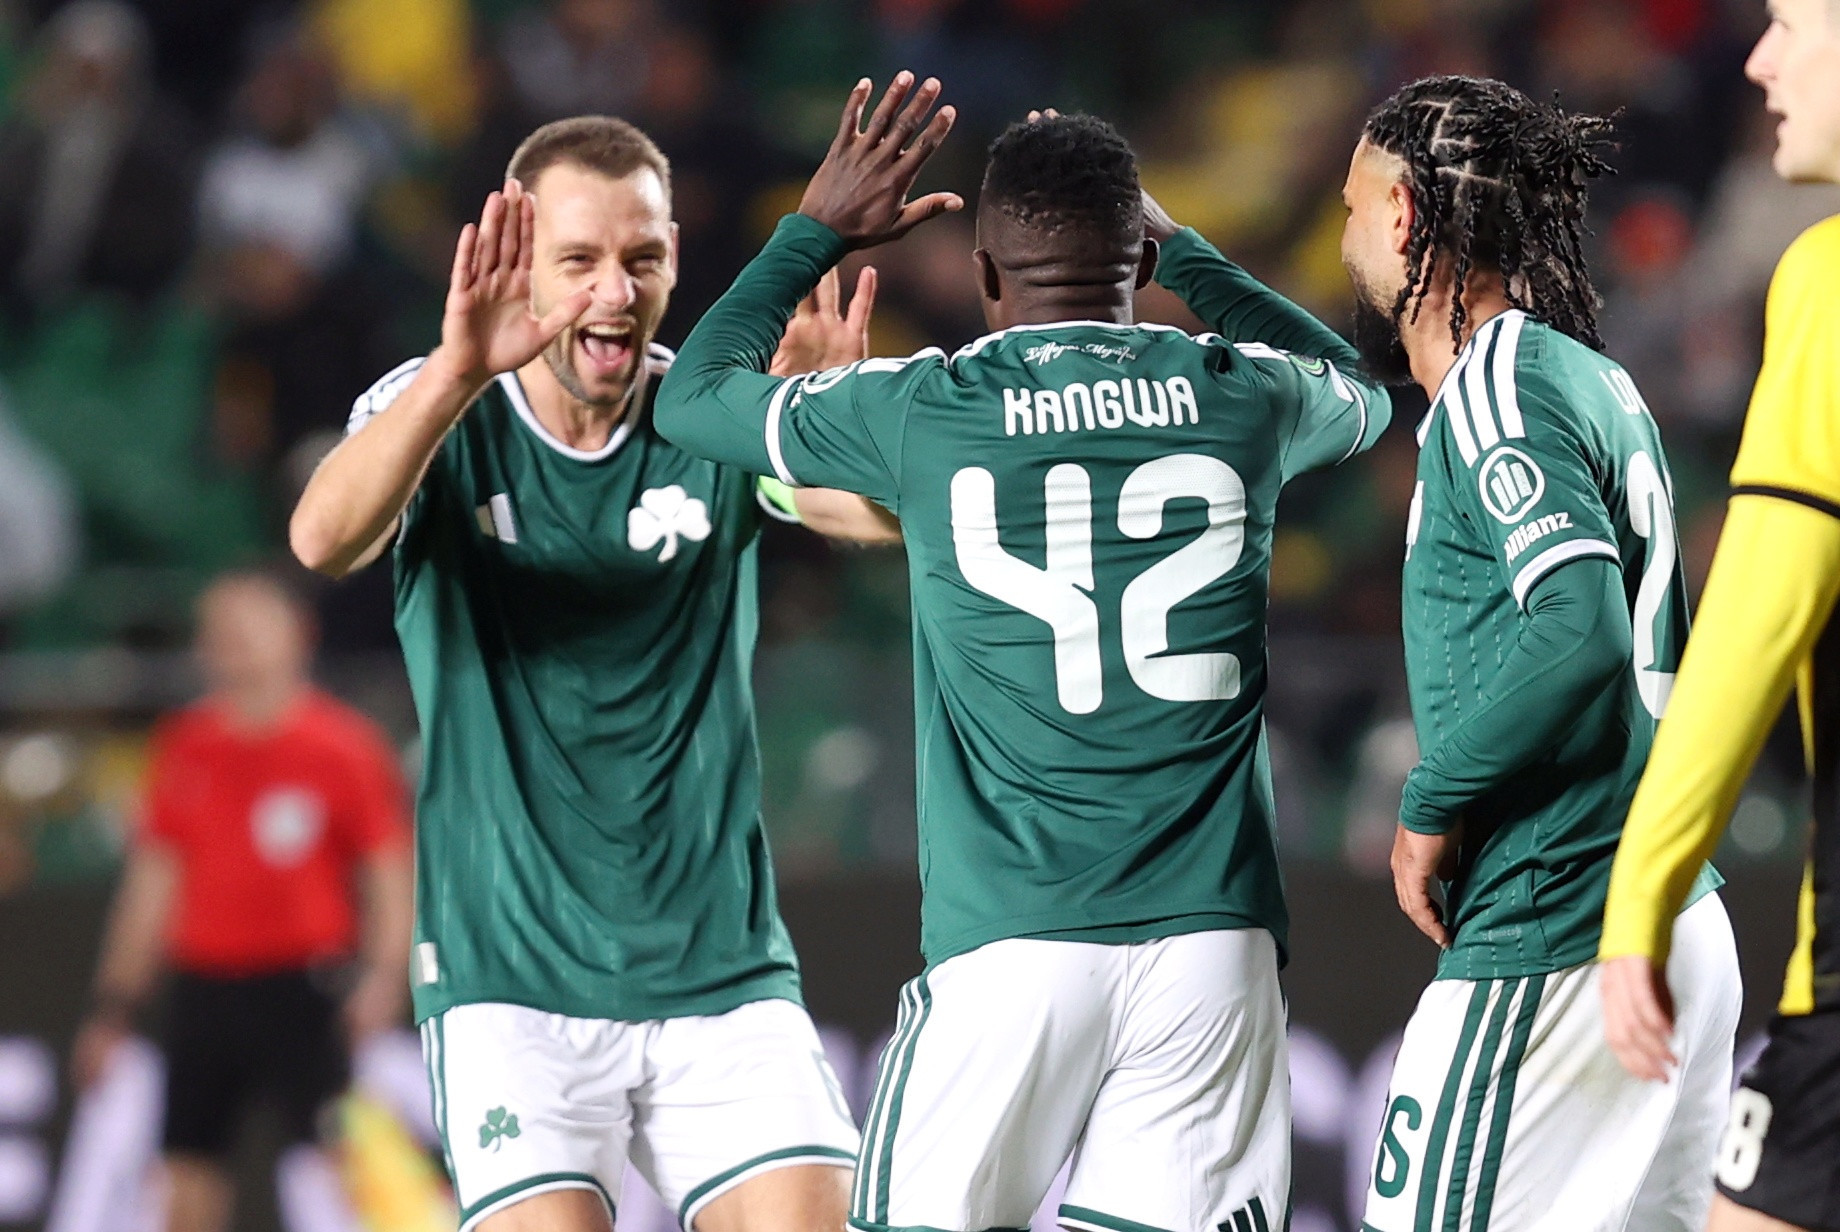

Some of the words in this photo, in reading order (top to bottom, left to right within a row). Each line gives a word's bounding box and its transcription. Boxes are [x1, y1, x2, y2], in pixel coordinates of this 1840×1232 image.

[1003, 376, 1199, 436] KANGWA
[1504, 511, 1574, 568] Allianz
[950, 453, 1247, 714] 42
